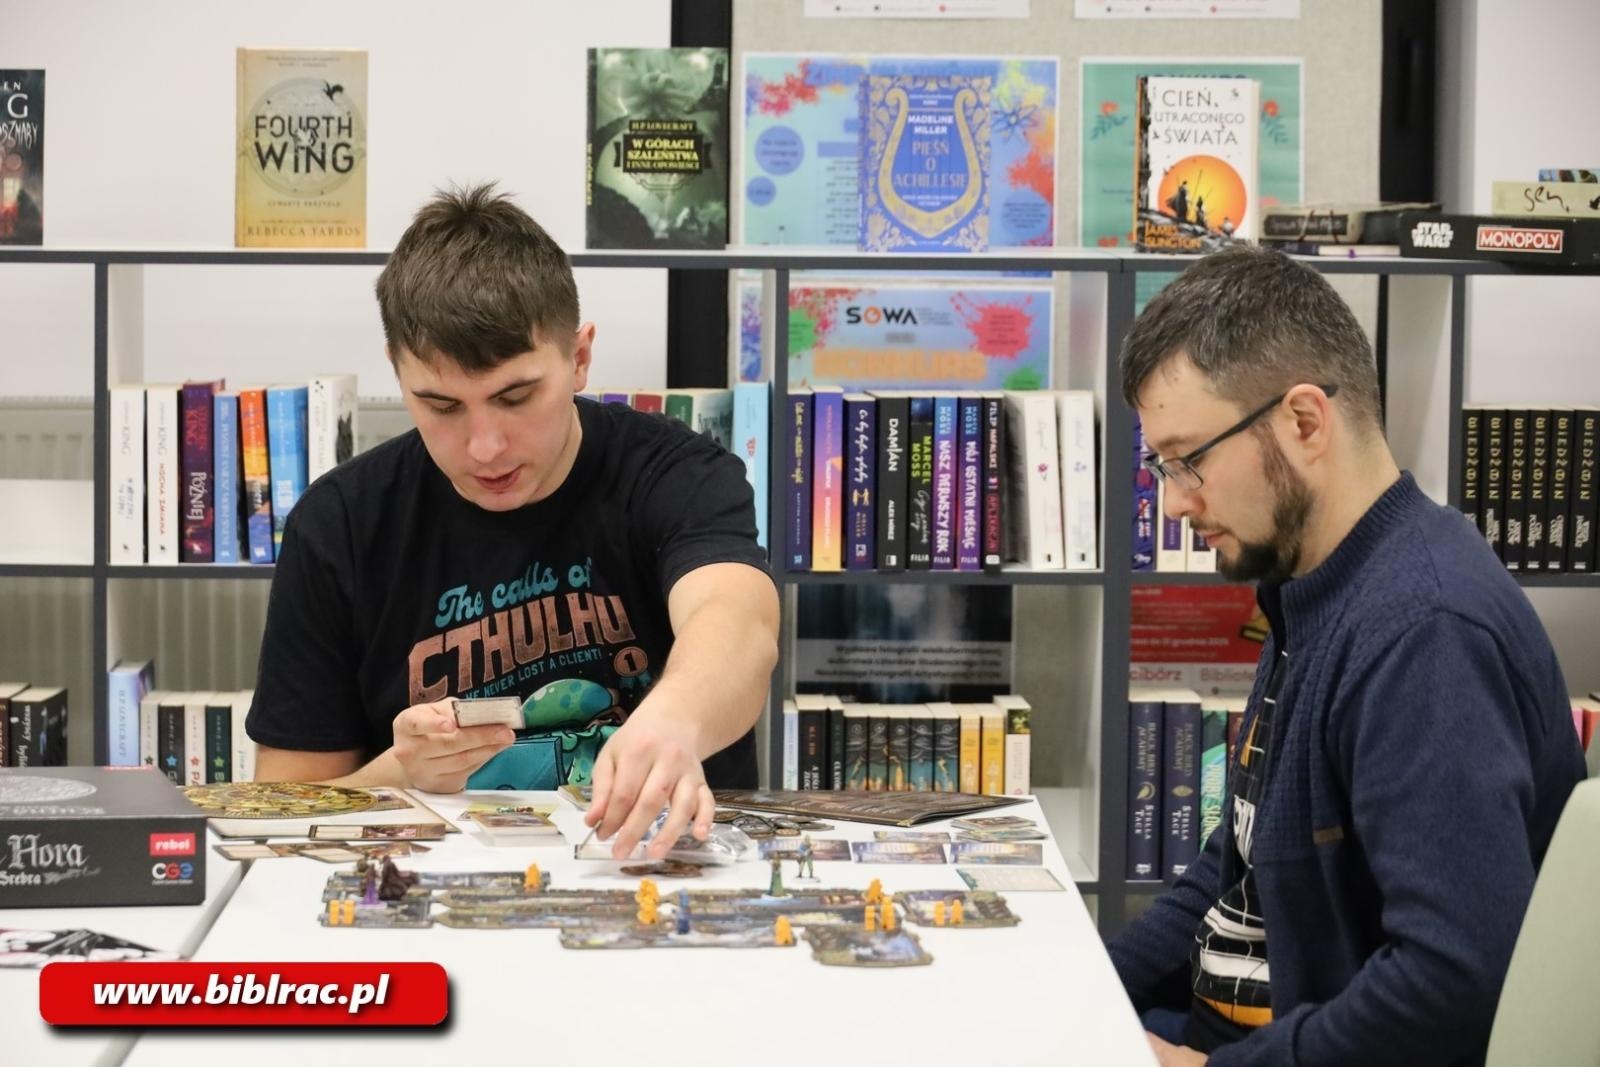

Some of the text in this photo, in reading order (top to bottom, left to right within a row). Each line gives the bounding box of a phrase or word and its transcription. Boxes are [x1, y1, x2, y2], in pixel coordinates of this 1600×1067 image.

[255, 116, 352, 138] FOURTH
[907, 115, 954, 124] MADELINE
[913, 125, 948, 135] MILLER
[1154, 112, 1245, 125] UTRACONEGO
[632, 136, 695, 150] W GÓRACH
[1164, 127, 1239, 145] ŚWIATA
[254, 141, 355, 173] WING
[626, 150, 699, 161] SZALEŃSTWA
[926, 157, 936, 171] O
[247, 225, 361, 237] REBECCA YARROS
[1411, 231, 1454, 248] WARS
[1416, 222, 1451, 235] STAR
[1479, 230, 1560, 249] MONOPOLY
[846, 306, 918, 326] SOWA
[186, 409, 198, 446] KING
[911, 443, 920, 478] MOSS
[922, 435, 931, 485] MARCEL
[937, 440, 951, 471] NASZ
[965, 441, 980, 463] MÓJ
[185, 471, 208, 521] PÓŹNIEJ
[964, 465, 977, 507] OSTATNI
[936, 529, 951, 554] ROK
[434, 556, 592, 628] The calls of
[408, 592, 637, 707] CTHULHU
[483, 677, 516, 699] NEVER
[518, 661, 545, 681] LOST
[549, 658, 557, 670] A
[559, 648, 603, 667] CLIENT!
[1136, 726, 1147, 771] ACADEMY
[1134, 809, 1144, 835] TACK
[1144, 805, 1155, 840] STELLA
[1171, 810, 1181, 836] TACK
[1181, 805, 1192, 840] STELLA
[7, 832, 90, 869] Hora
[154, 838, 191, 851] rebel
[151, 862, 194, 881] CGE
